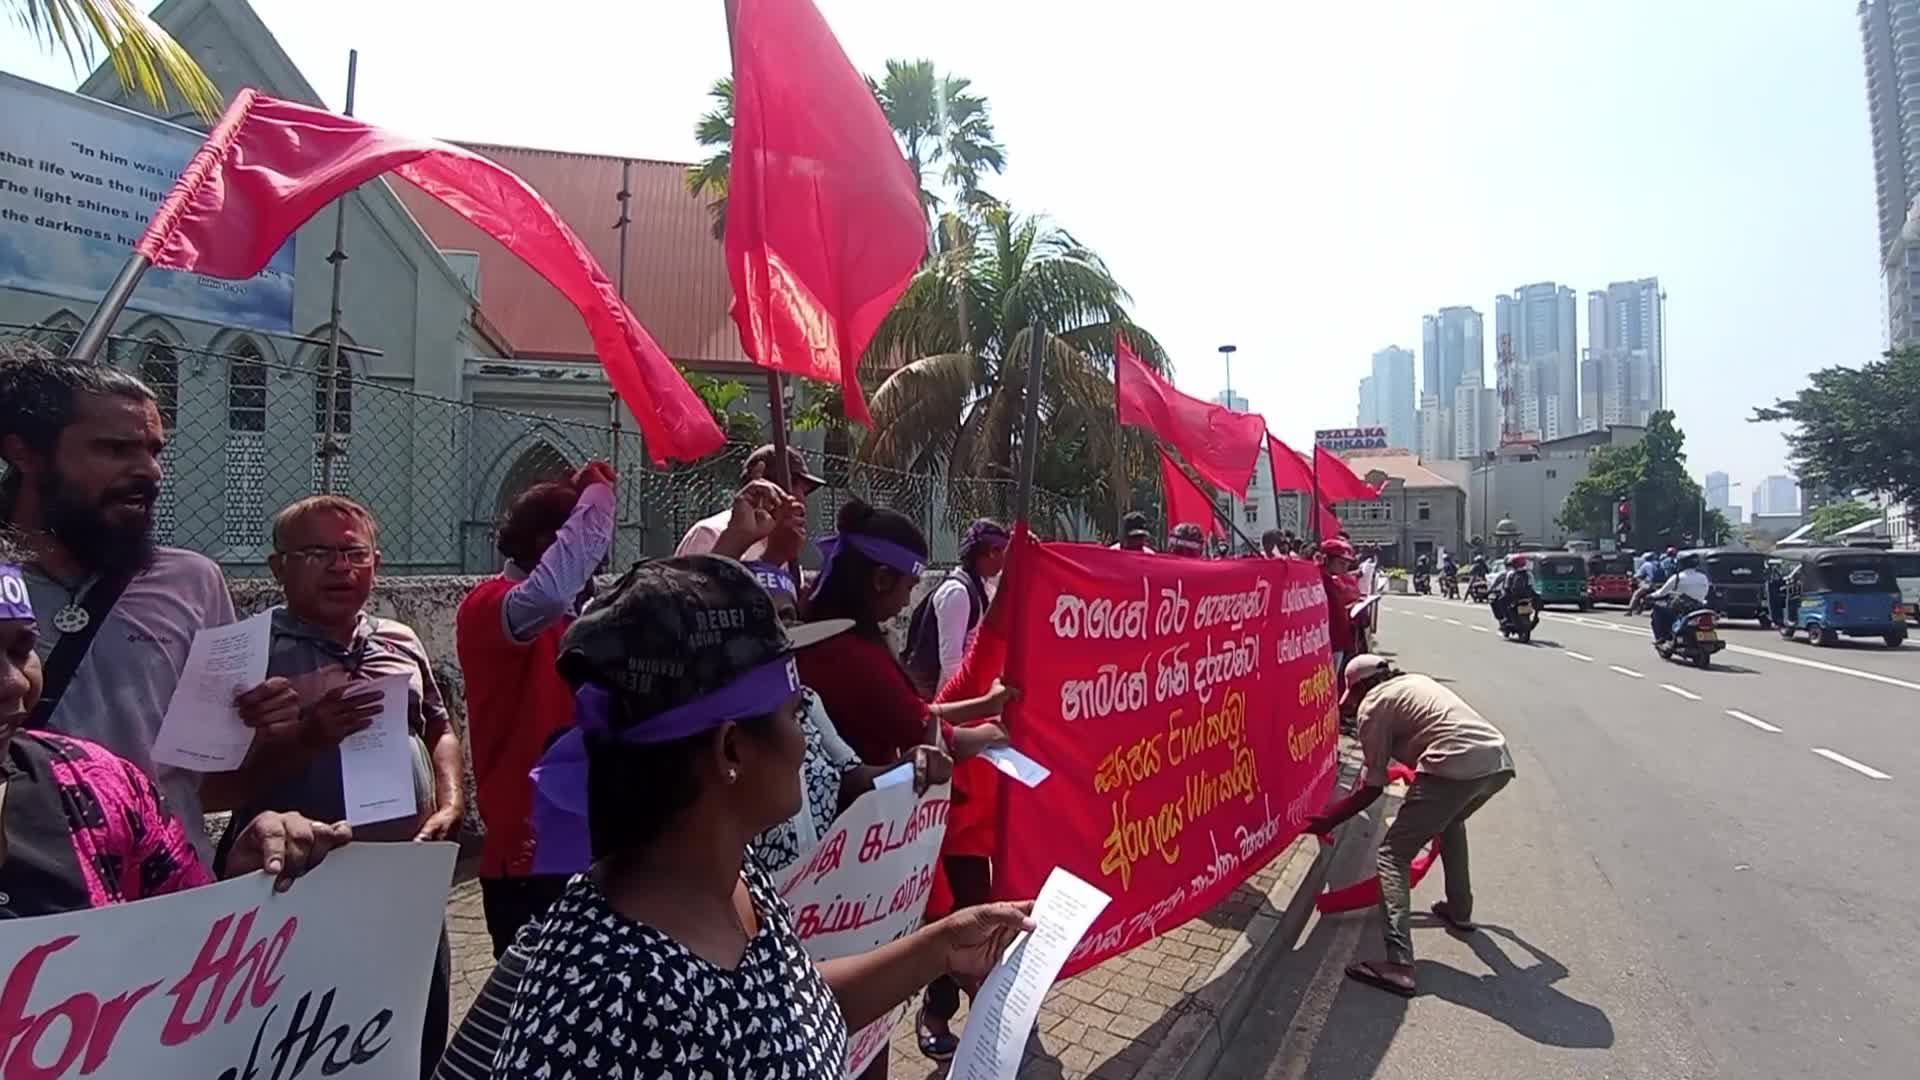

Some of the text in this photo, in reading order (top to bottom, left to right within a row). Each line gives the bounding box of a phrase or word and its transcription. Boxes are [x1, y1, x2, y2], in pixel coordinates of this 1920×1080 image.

[0, 151, 168, 203] that life was the ligh
[100, 150, 128, 167] him
[133, 161, 165, 178] was
[0, 178, 149, 224] The light shines in
[1, 208, 137, 247] the darkness ha
[0, 906, 298, 1080] for the
[271, 987, 394, 1080] the
